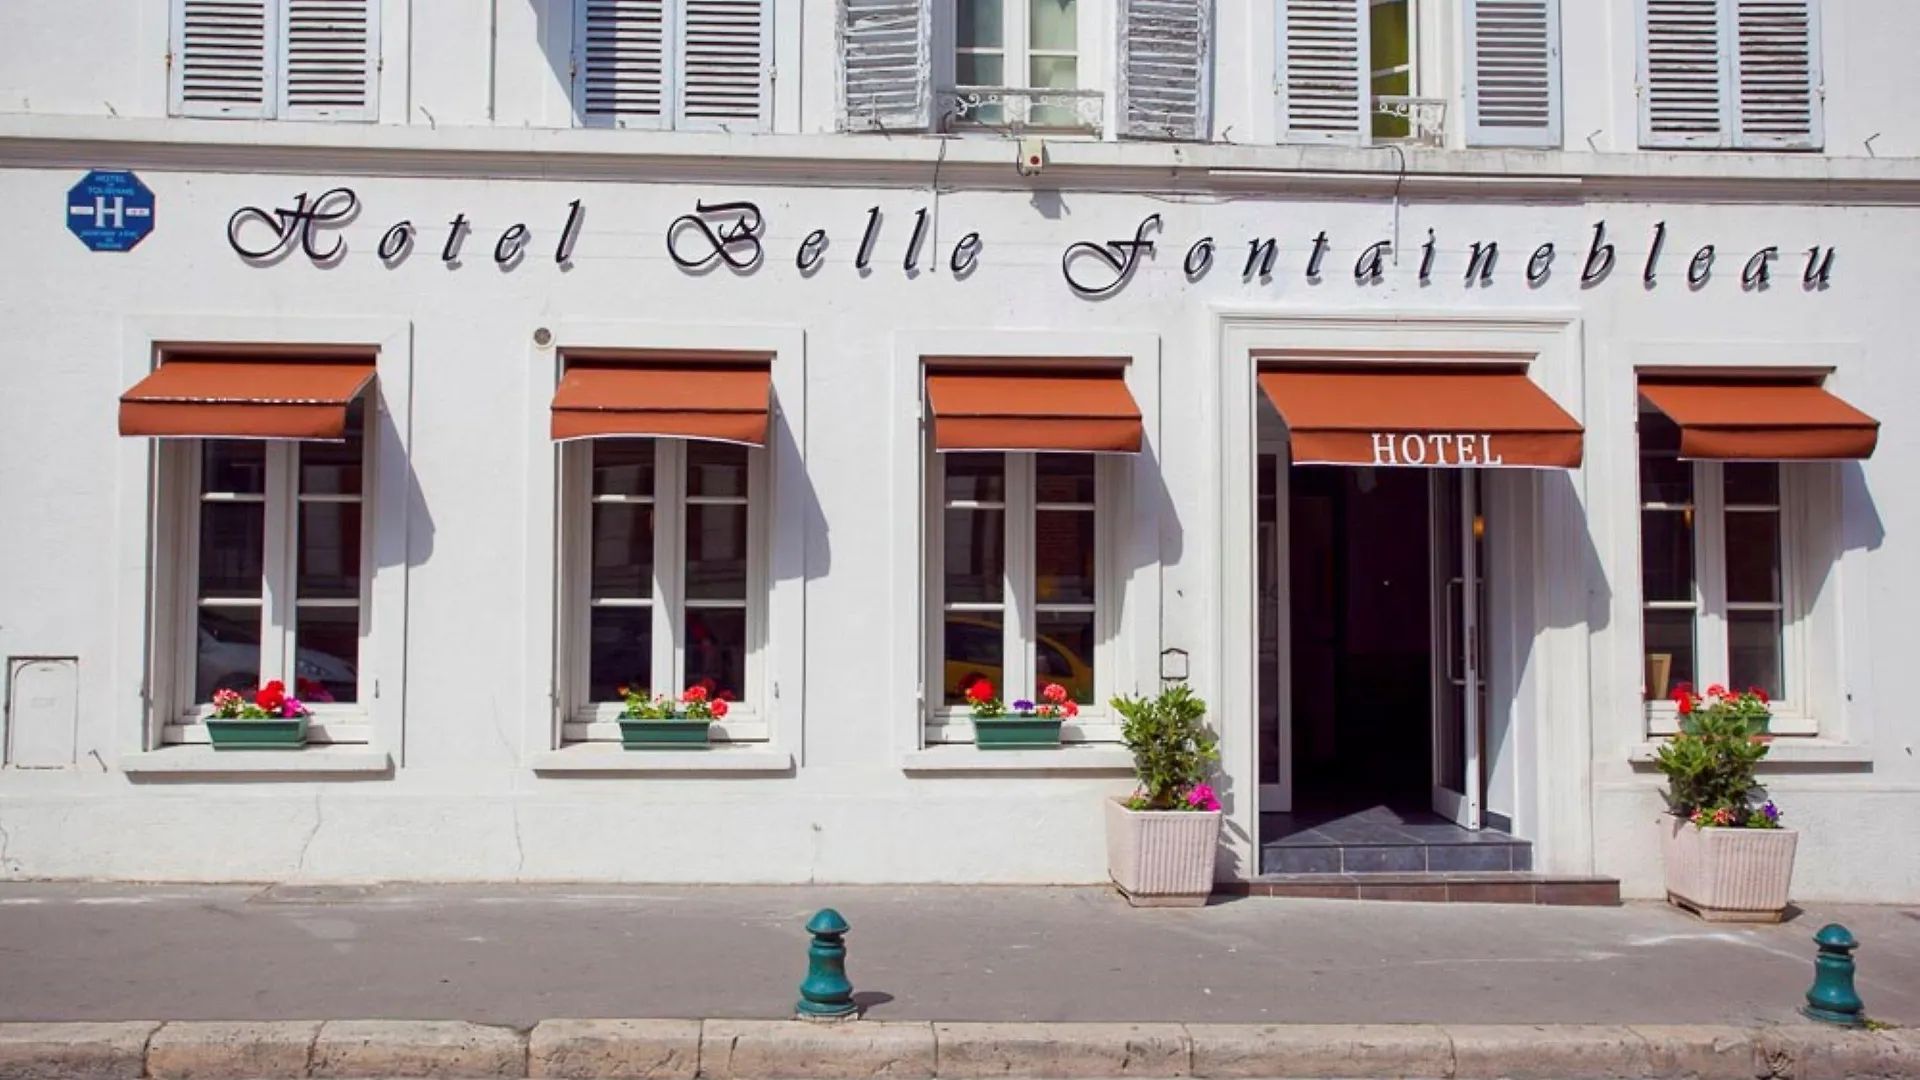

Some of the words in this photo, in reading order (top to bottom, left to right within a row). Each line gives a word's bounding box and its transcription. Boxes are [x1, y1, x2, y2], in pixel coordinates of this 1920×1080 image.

[95, 196, 124, 228] H
[228, 188, 581, 264] Hotel
[667, 199, 980, 271] Belle
[1062, 214, 1835, 294] Fontainebleau
[1371, 433, 1502, 466] HOTEL
